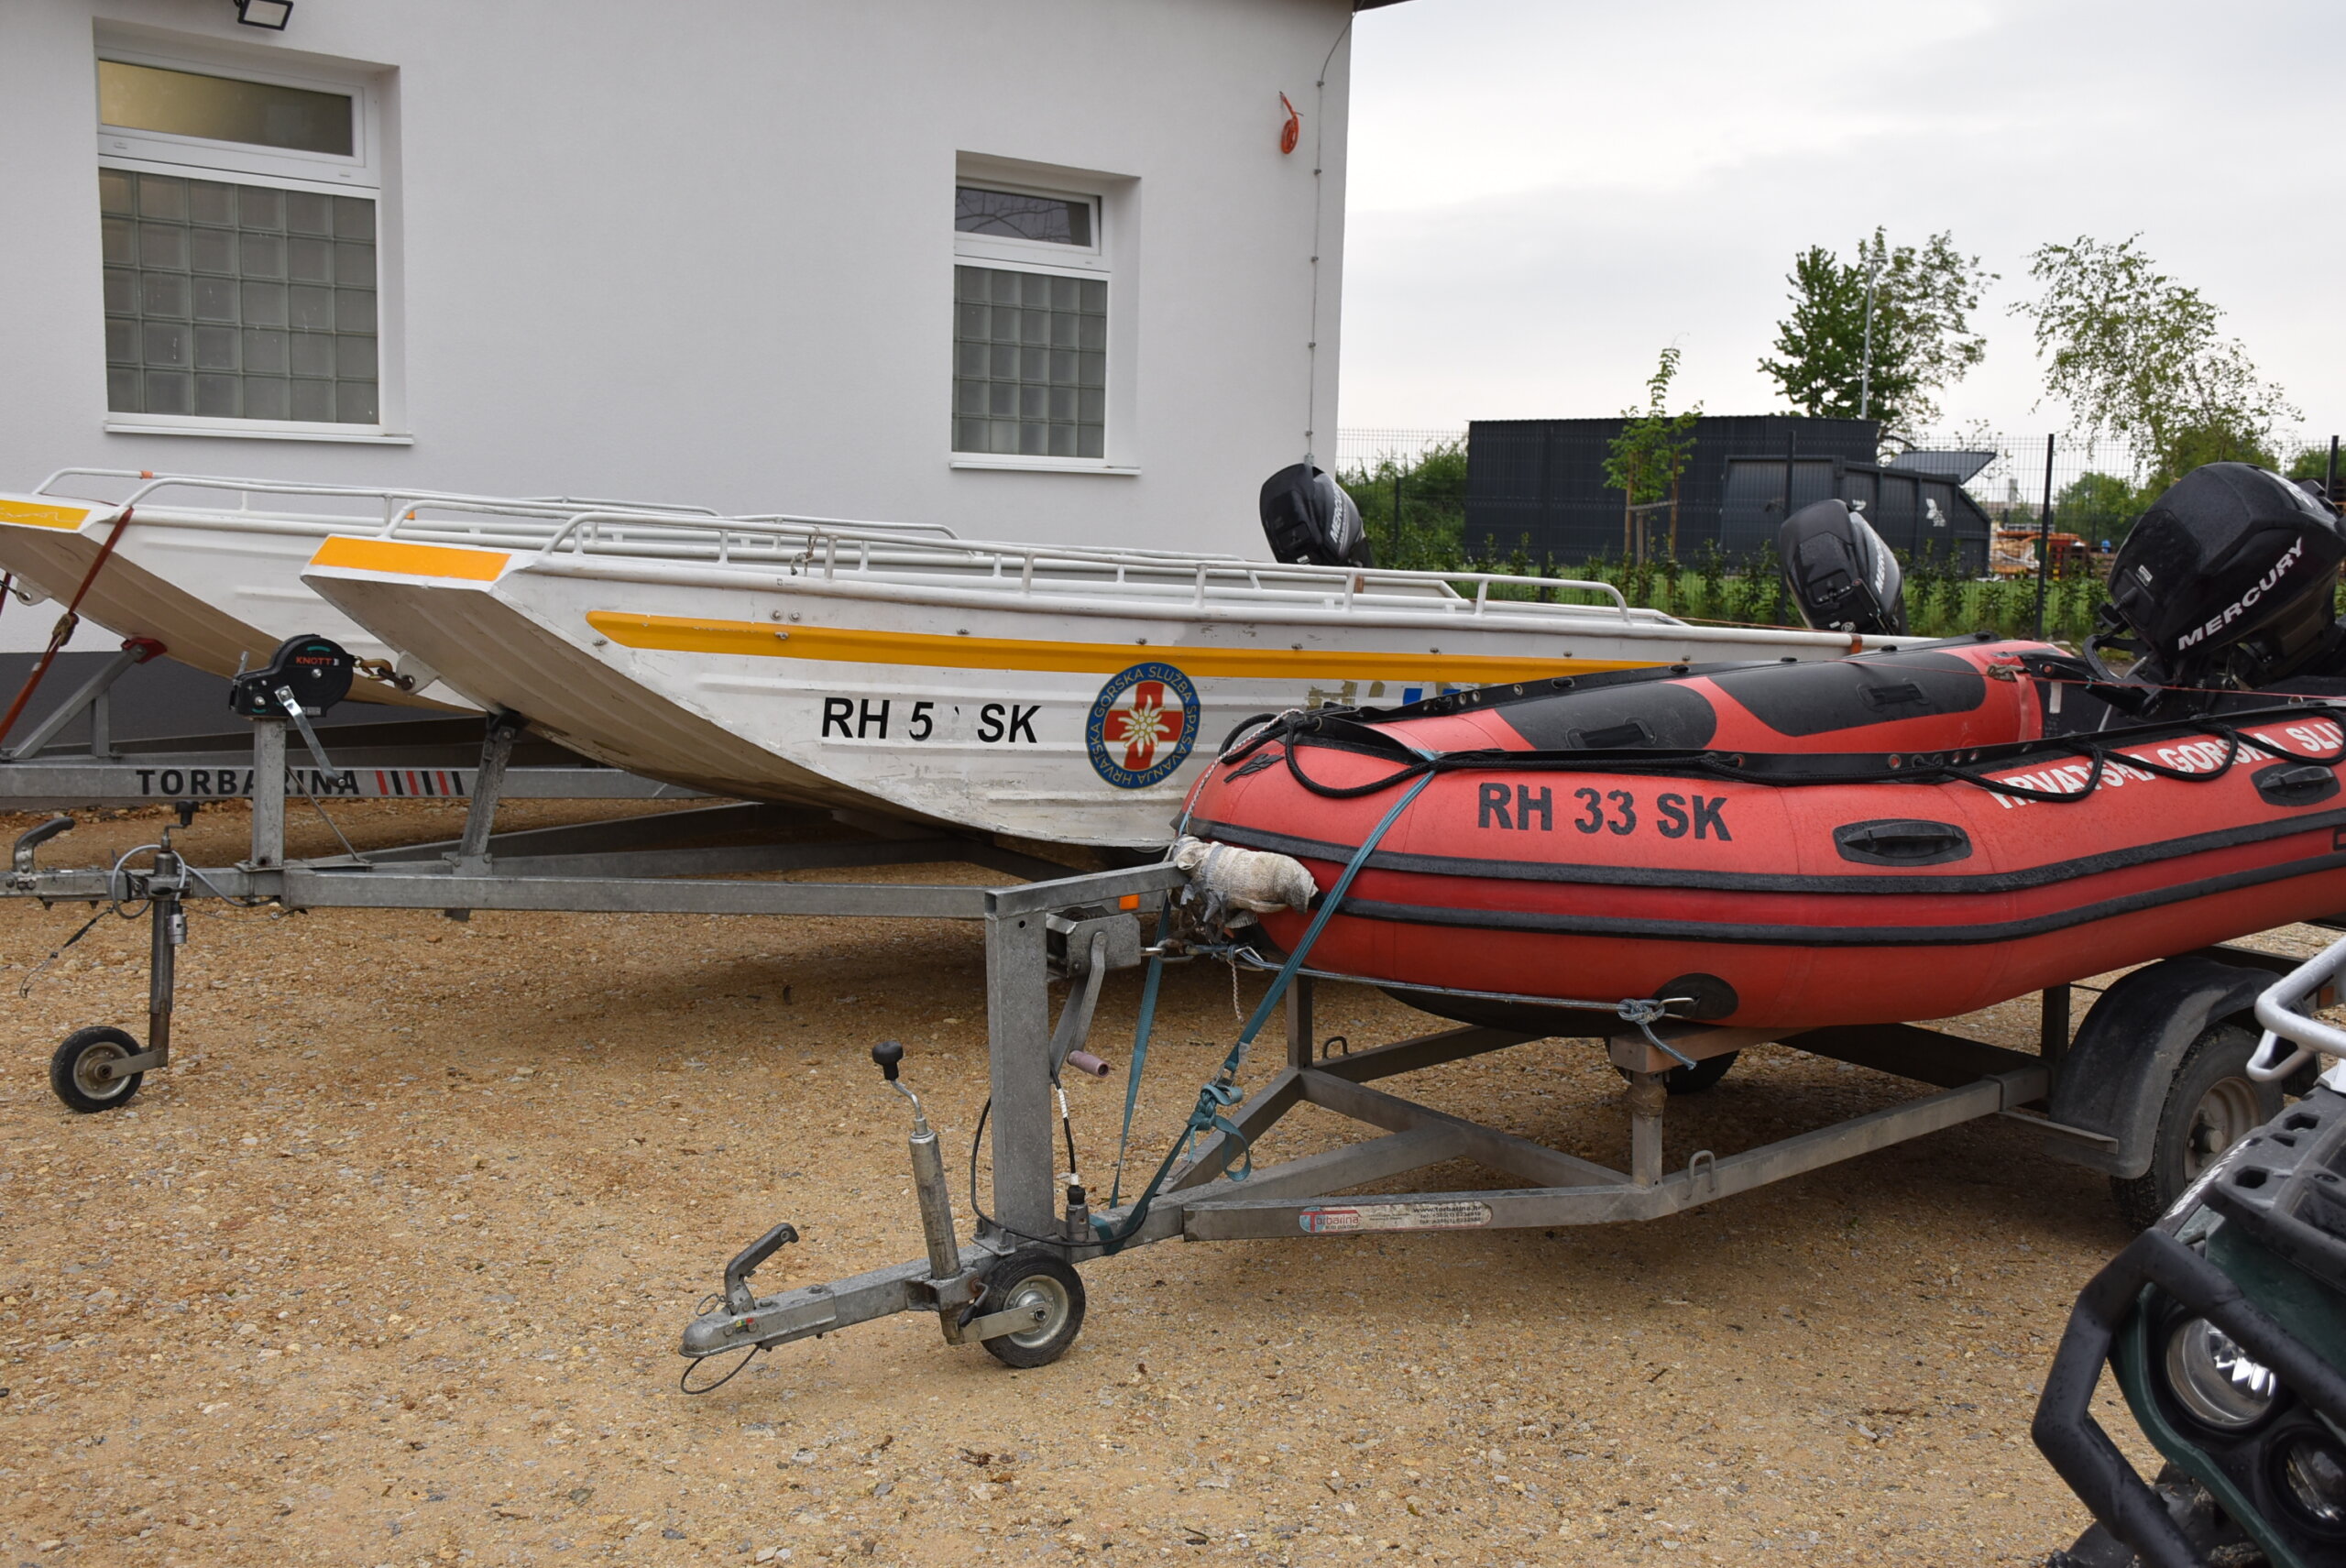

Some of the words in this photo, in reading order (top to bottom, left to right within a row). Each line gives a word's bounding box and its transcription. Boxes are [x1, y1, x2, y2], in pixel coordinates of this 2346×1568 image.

[2177, 536, 2303, 651] MERCURY
[295, 656, 332, 665] KNOTT
[1148, 666, 1192, 703] SLUŽBA
[821, 696, 891, 740] RH
[977, 703, 1043, 743] SK
[1094, 668, 1145, 718] GORSKA
[1091, 722, 1134, 784] HRVATSKA
[1137, 705, 1197, 784] SPASAVANJA
[1477, 782, 1552, 831] RH
[1573, 787, 1637, 836] 33
[1656, 793, 1733, 841] SK
